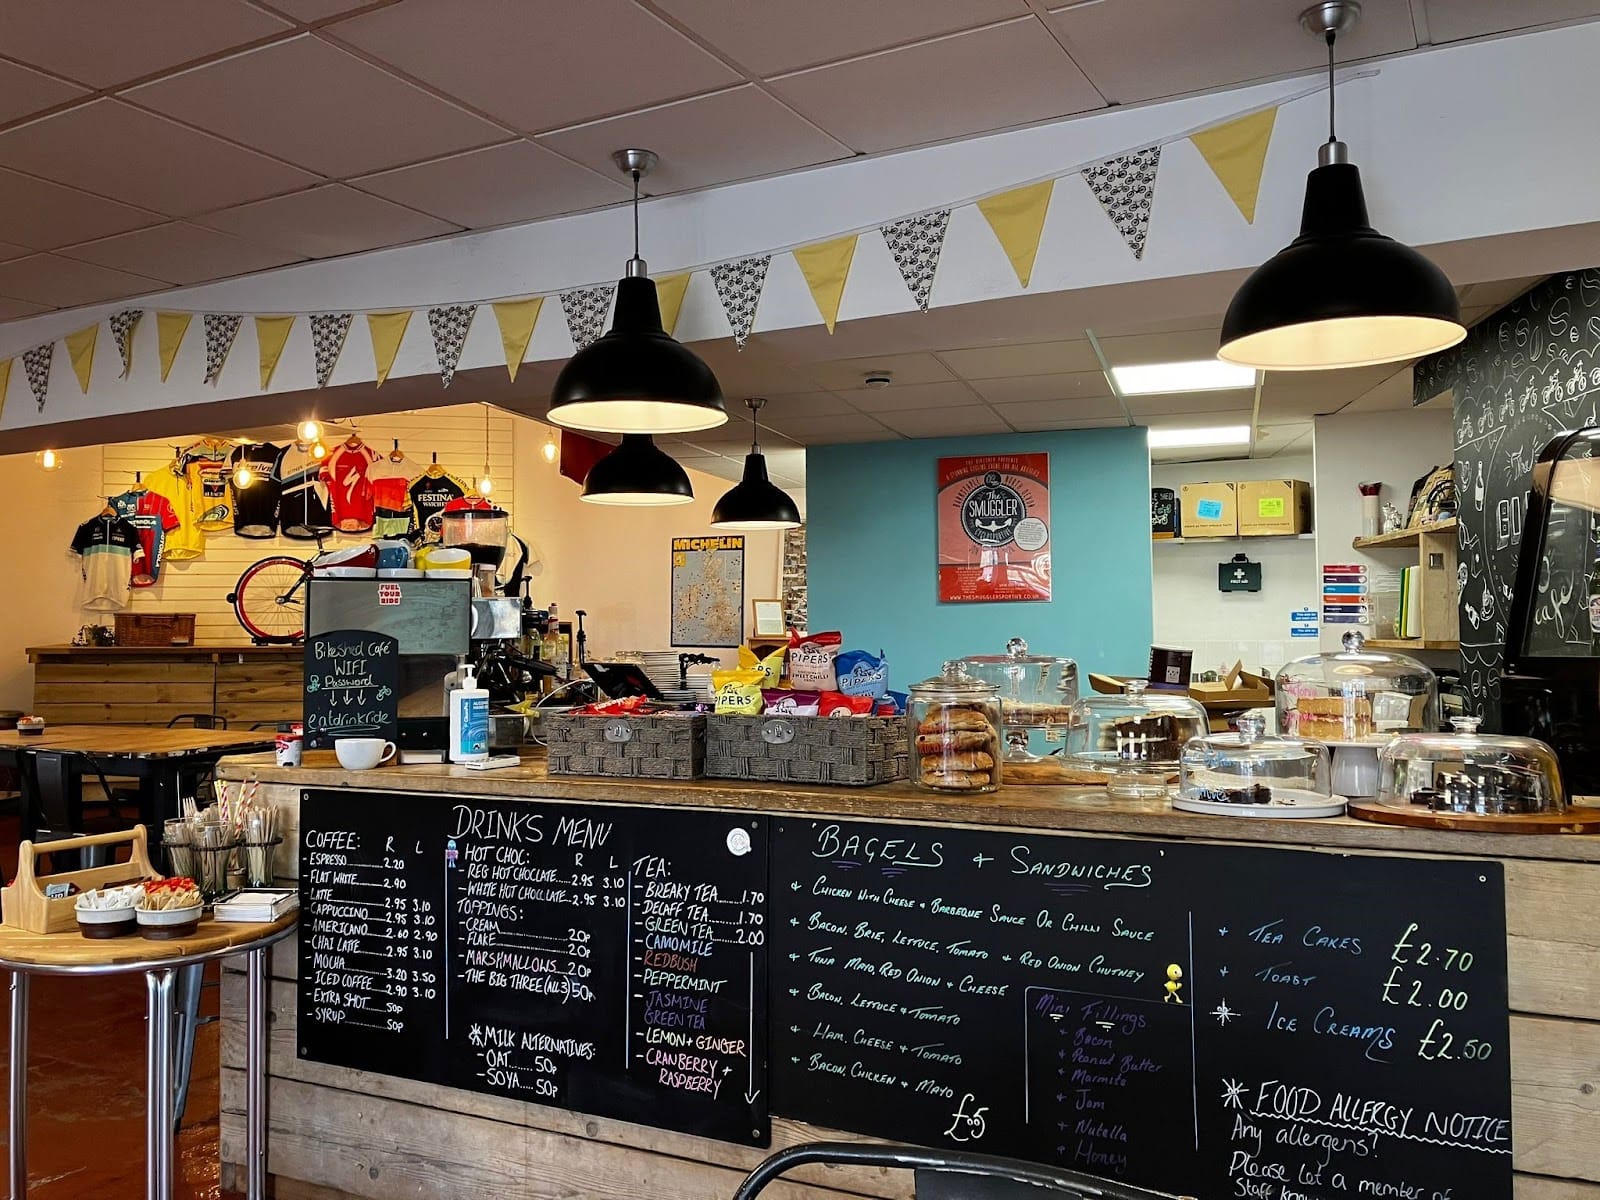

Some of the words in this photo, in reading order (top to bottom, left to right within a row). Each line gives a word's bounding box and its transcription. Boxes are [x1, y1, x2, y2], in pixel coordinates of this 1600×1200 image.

[418, 494, 453, 502] FESTINA
[969, 498, 1018, 518] SMUGGLER
[673, 538, 743, 550] MICHELIN
[314, 641, 364, 660] Bikeshed
[368, 641, 392, 657] Café
[791, 652, 829, 664] PIPERS
[334, 659, 367, 676] WIFI
[325, 674, 373, 688] Password
[714, 695, 752, 706] PIPERS
[447, 804, 544, 843] DRINKS
[552, 816, 613, 849] MENU
[306, 830, 361, 850] COFFEE:
[385, 836, 395, 852] R
[415, 841, 423, 854] L
[310, 852, 347, 866] ESPRESSO
[383, 857, 405, 870] 2.20
[464, 843, 495, 862] HOT
[496, 846, 530, 866] CHOC:
[575, 853, 584, 867] R
[610, 856, 618, 869] L
[633, 855, 671, 878] TEA:
[812, 824, 944, 868] BAGELS
[1010, 845, 1152, 890] SANDWICHES
[310, 870, 331, 884] FLAT
[332, 871, 358, 885] WHITE
[383, 879, 407, 889] 2.90
[467, 863, 489, 879] REG
[492, 865, 515, 880] HOT
[571, 874, 595, 887] 2.95
[602, 877, 625, 890] 3.10
[311, 888, 333, 901] LATTE
[385, 898, 407, 911] 2.95
[412, 899, 431, 912] 3.10
[467, 881, 497, 897] WHITE
[499, 882, 517, 899] HOT
[572, 894, 598, 907] 2.95
[603, 895, 626, 908] 3.10
[645, 881, 691, 902] BREAKY
[694, 883, 718, 903] TEA
[742, 890, 765, 906] 1.70
[310, 904, 368, 920] CAPPUCCINO
[385, 912, 408, 926] 2.95
[413, 914, 435, 926] 3.10
[457, 897, 524, 922] TOPPINGS:
[642, 900, 682, 917] DECAFF
[687, 905, 709, 923] TEA
[738, 911, 764, 925] 1.70
[311, 919, 368, 935] AMERICANO
[385, 928, 409, 940] 2.60
[413, 929, 438, 942] 2.90
[465, 917, 501, 934] CREAM
[568, 928, 591, 943] 20p
[645, 916, 688, 936] GREEN
[691, 925, 714, 940] TEA
[736, 929, 764, 945] 2.00
[311, 935, 334, 950] CHAI
[337, 937, 360, 953] LATTE
[386, 945, 408, 957] 2.95
[412, 949, 432, 960] 3.10
[467, 932, 497, 946] FLAKE
[568, 943, 591, 958] 20p
[646, 934, 714, 956] CAMOMILE
[1249, 919, 1284, 945] TEA
[1302, 925, 1362, 955] CAKES
[1391, 923, 1473, 972] £2.70
[313, 952, 345, 969] MOCHA
[386, 968, 408, 982] 3.20
[412, 970, 436, 983] 3.50
[466, 950, 557, 973] MARSHMALLOWS
[568, 962, 592, 978] 20p
[644, 950, 698, 972] REDBUSH
[315, 971, 340, 986] ICED
[341, 974, 374, 990] COFFEE
[385, 985, 408, 998] 2.90
[412, 986, 436, 999] 3.10
[465, 968, 486, 983] THE
[488, 971, 507, 987] BIG
[510, 974, 543, 993] THREE
[643, 969, 728, 993] PEPPERMINT
[1255, 961, 1318, 987] TOAST
[1382, 965, 1469, 1011] £2.00
[313, 988, 341, 1005] EXTRA
[343, 994, 371, 1010] SHOT
[646, 991, 708, 1013] JASMINE
[315, 1008, 346, 1023] SYRUP
[644, 1009, 684, 1027] GREEN
[687, 1015, 705, 1029] TEA
[1035, 993, 1070, 1017] Mini
[1081, 1001, 1147, 1035] Fillings
[484, 1025, 515, 1047] MILK
[521, 1032, 596, 1060] ALTERNATIVES:
[646, 1027, 685, 1047] LEMON
[695, 1035, 747, 1057] GINGER
[1073, 1027, 1113, 1048] Bacon
[1266, 1001, 1297, 1032] ICE
[1313, 1006, 1397, 1064] CREAMS
[1417, 1018, 1493, 1061] £2.50
[486, 1050, 513, 1068] OAT
[535, 1056, 557, 1075] 50p
[646, 1048, 718, 1079] CRANBERRY
[1072, 1048, 1116, 1065] Peanut
[1120, 1055, 1163, 1073] Butter
[487, 1068, 520, 1089] SOYA
[536, 1079, 559, 1098] 50p
[659, 1068, 722, 1100] RASPBERRY
[1071, 1069, 1128, 1086] Marmite
[1075, 1088, 1105, 1110] Jam
[1255, 1080, 1321, 1117] FOOD
[1329, 1092, 1413, 1137] ALLERGY
[1424, 1112, 1511, 1143] NOTICE
[1075, 1119, 1128, 1143] Nutella
[1230, 1113, 1262, 1158] Any
[1276, 1124, 1378, 1167] allergens?
[1075, 1139, 1128, 1174] Honey
[1229, 1151, 1290, 1183] Please
[1332, 1173, 1347, 1190] a
[1359, 1180, 1424, 1200] member
[1234, 1177, 1273, 1198] Staff
